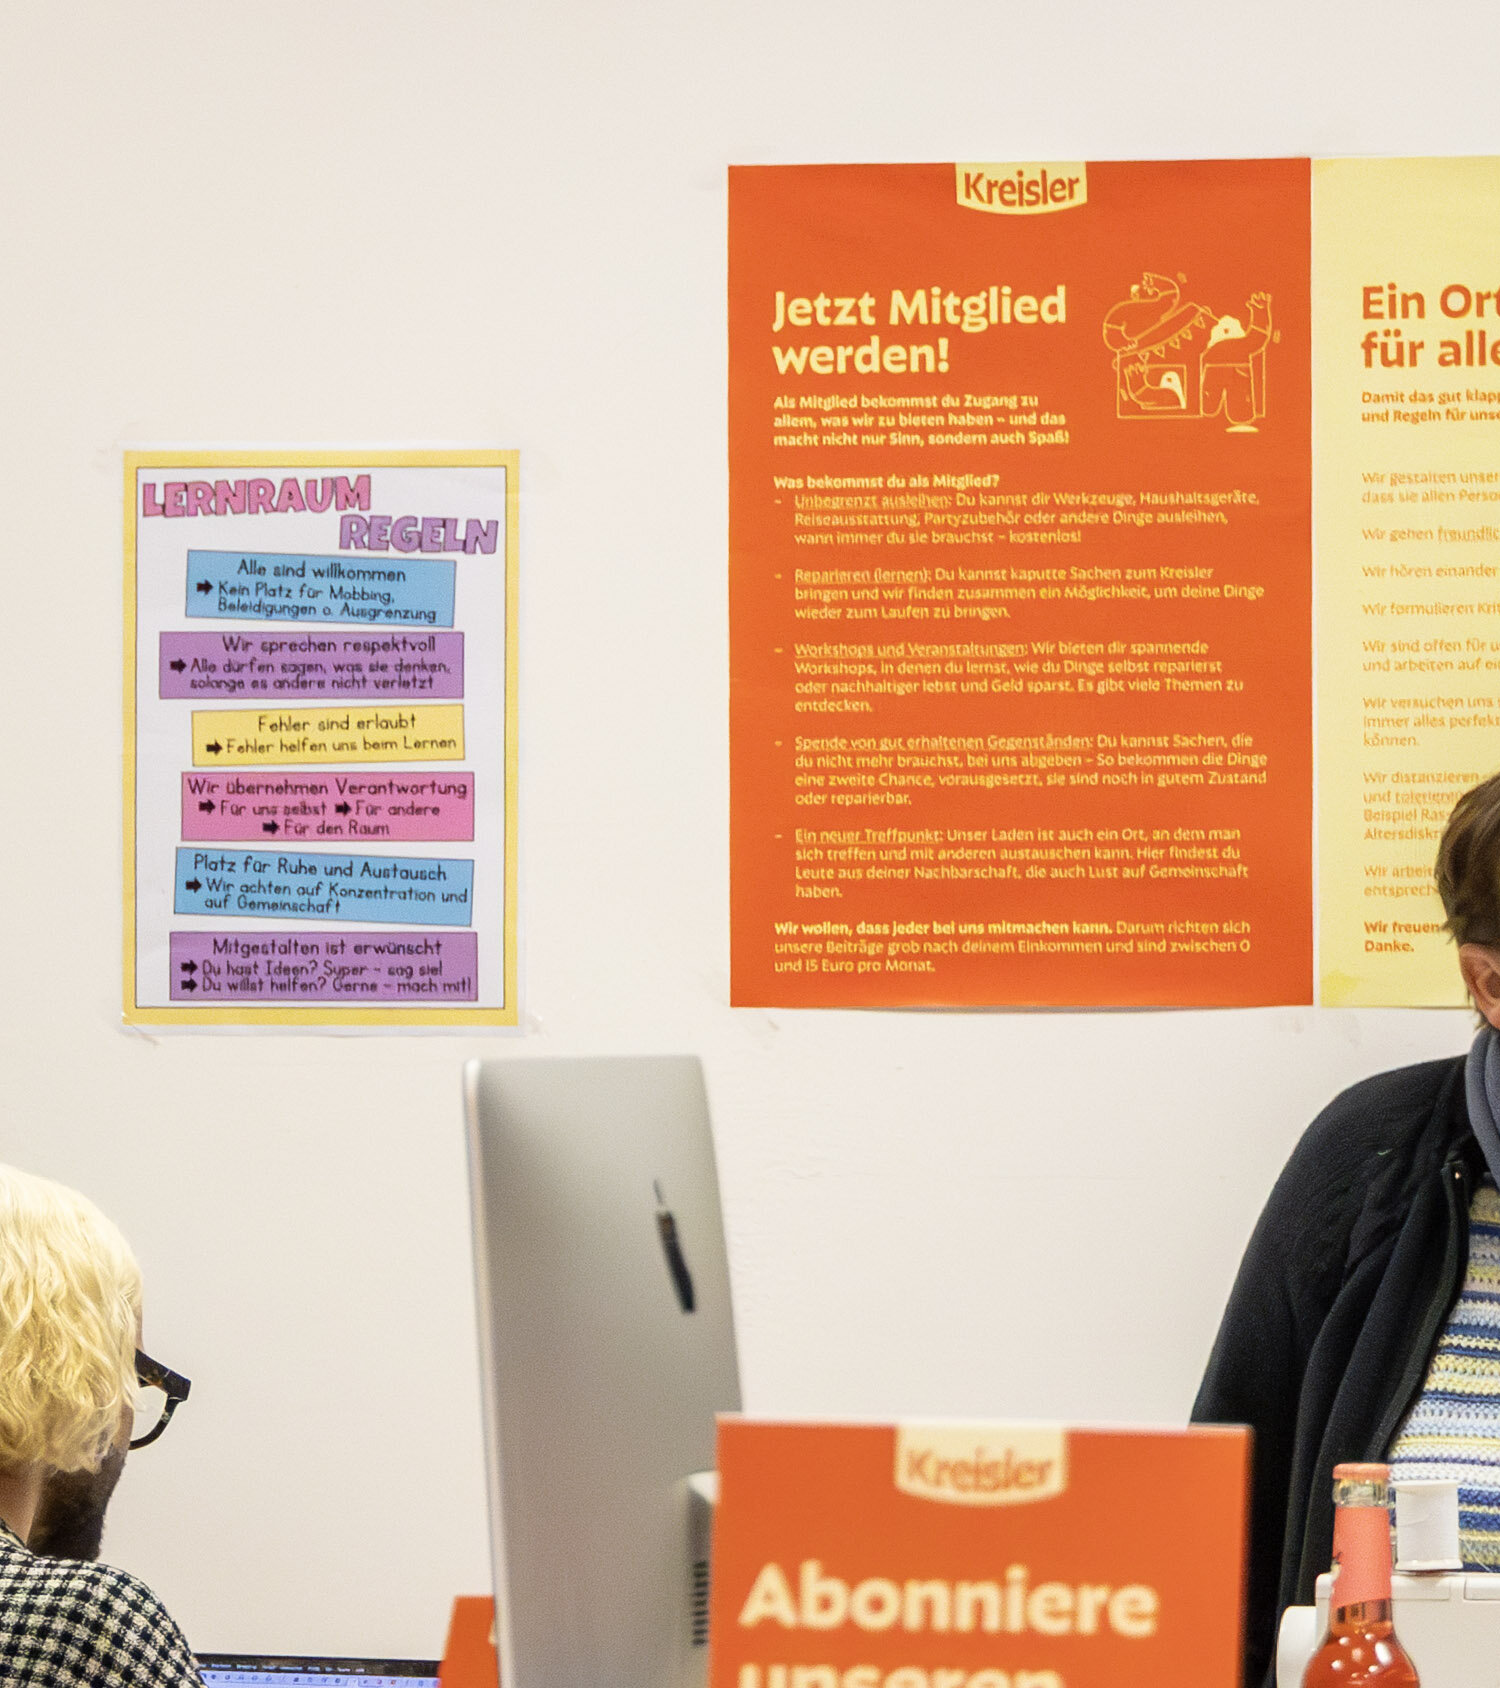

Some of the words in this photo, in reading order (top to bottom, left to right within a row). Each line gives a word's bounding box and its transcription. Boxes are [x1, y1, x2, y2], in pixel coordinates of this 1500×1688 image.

[963, 170, 1080, 207] Kreisler
[772, 290, 876, 333] Jetzt
[889, 284, 1067, 333] Mitglied
[1362, 283, 1426, 320] Ein
[771, 335, 950, 375] werden!
[1360, 328, 1425, 369] für
[773, 394, 796, 409] Als
[798, 394, 858, 412] Mitglied
[860, 394, 938, 409] bekommst
[940, 393, 961, 408] du
[963, 393, 1018, 410] Zugang
[1020, 395, 1039, 407] zu
[1361, 391, 1405, 404] Damit
[1408, 389, 1435, 404] das
[1437, 391, 1462, 406] gut
[820, 415, 850, 428] was
[851, 413, 875, 427] wir
[877, 415, 896, 427] zu
[947, 412, 994, 427] haben
[1008, 411, 1038, 426] und
[1039, 411, 1067, 426] das
[1361, 409, 1390, 423] und
[1392, 408, 1442, 425] Regeln
[1444, 407, 1467, 422] für
[773, 431, 819, 447] macht
[821, 431, 858, 446] nicht
[861, 434, 887, 445] nur
[889, 431, 925, 447] Sinn,
[927, 431, 988, 445] sondern
[990, 430, 1026, 445] auch
[1028, 430, 1070, 447] Spaß!
[773, 476, 805, 489] Was
[806, 474, 884, 489] bekommst
[886, 474, 907, 489] du
[908, 474, 930, 488] als
[932, 473, 1000, 491] Mitglied?
[142, 474, 371, 517] LERNRAUM
[339, 514, 499, 555] REGELN
[236, 558, 267, 577] Alle
[272, 561, 306, 579] sind
[311, 562, 407, 582] willkommen
[217, 581, 252, 598] Kein
[253, 581, 294, 600] Platz
[298, 583, 323, 599] für
[217, 599, 318, 619] Beleidigungen
[339, 603, 437, 625] Ausgrenzung
[221, 635, 254, 653] Wir
[260, 635, 338, 656] sprechen
[342, 635, 436, 657] respektvoll
[190, 657, 218, 677] Alle
[222, 657, 275, 674] dürfen
[332, 661, 364, 676] was
[368, 660, 389, 673] sie
[189, 674, 246, 693] solange
[250, 678, 269, 690] es
[272, 673, 326, 690] andere
[331, 673, 368, 690] nicht
[373, 673, 434, 690] verletzt
[257, 714, 311, 733] Fehler
[317, 714, 350, 732] sind
[356, 712, 416, 730] erlaubt
[226, 737, 275, 754] Fehler
[279, 736, 328, 753] helfen
[331, 741, 358, 752] uns
[362, 736, 399, 751] beim
[402, 735, 457, 750] Lernen
[187, 777, 220, 796] Wir
[225, 777, 329, 796] übernehmen
[334, 778, 468, 800] Verantwortung
[219, 799, 247, 817] Für
[251, 805, 278, 817] uns
[354, 799, 382, 817] Für
[387, 800, 441, 817] andere
[283, 818, 310, 836] Für
[315, 820, 344, 836] den
[348, 818, 390, 836] Raum
[193, 853, 237, 874] Platz
[243, 855, 271, 874] für
[277, 856, 318, 876] Ruhe
[323, 860, 354, 878] und
[359, 861, 448, 881] Austausch
[204, 877, 235, 894] Wir
[239, 879, 292, 897] achten
[296, 881, 324, 897] auf
[328, 882, 436, 902] Konzentration
[441, 887, 469, 904] und
[204, 894, 232, 909] auf
[236, 895, 341, 914] Gemeinschaft
[212, 937, 320, 959] Mitgestalten
[325, 939, 346, 956] ist
[353, 938, 443, 956] erwünscht
[201, 959, 222, 978] Du
[906, 1449, 1056, 1496] Kreisler
[739, 1559, 1161, 1638] Abonniere
